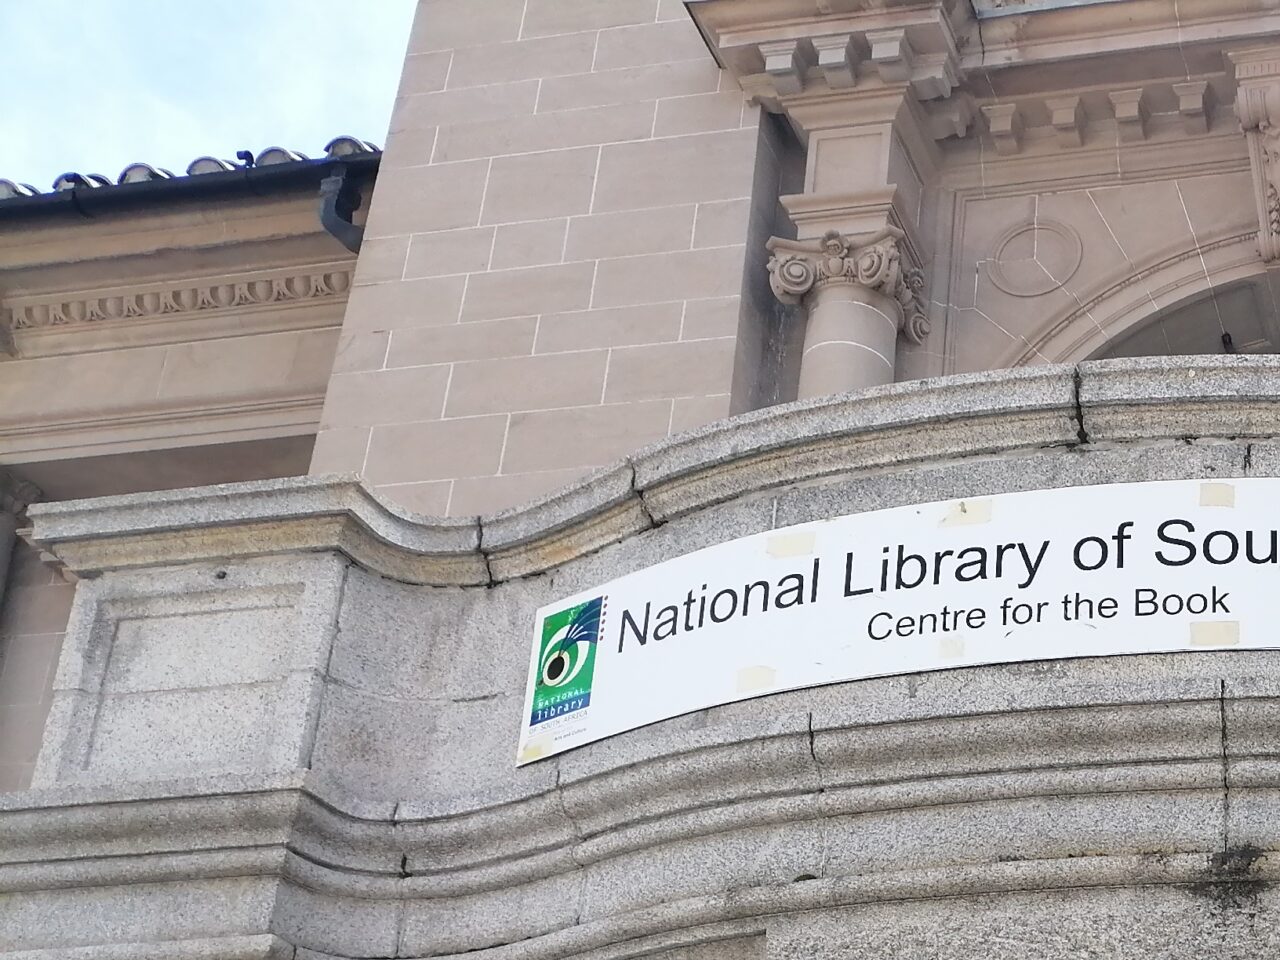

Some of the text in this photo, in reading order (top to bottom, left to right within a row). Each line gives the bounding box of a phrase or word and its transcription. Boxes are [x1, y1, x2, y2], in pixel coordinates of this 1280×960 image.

[617, 557, 820, 654] National
[843, 540, 1051, 598] Library
[1073, 521, 1134, 571] of
[867, 585, 1231, 641] Centre for the Book
[537, 698, 584, 720] library
[538, 688, 585, 709] NATIONAL
